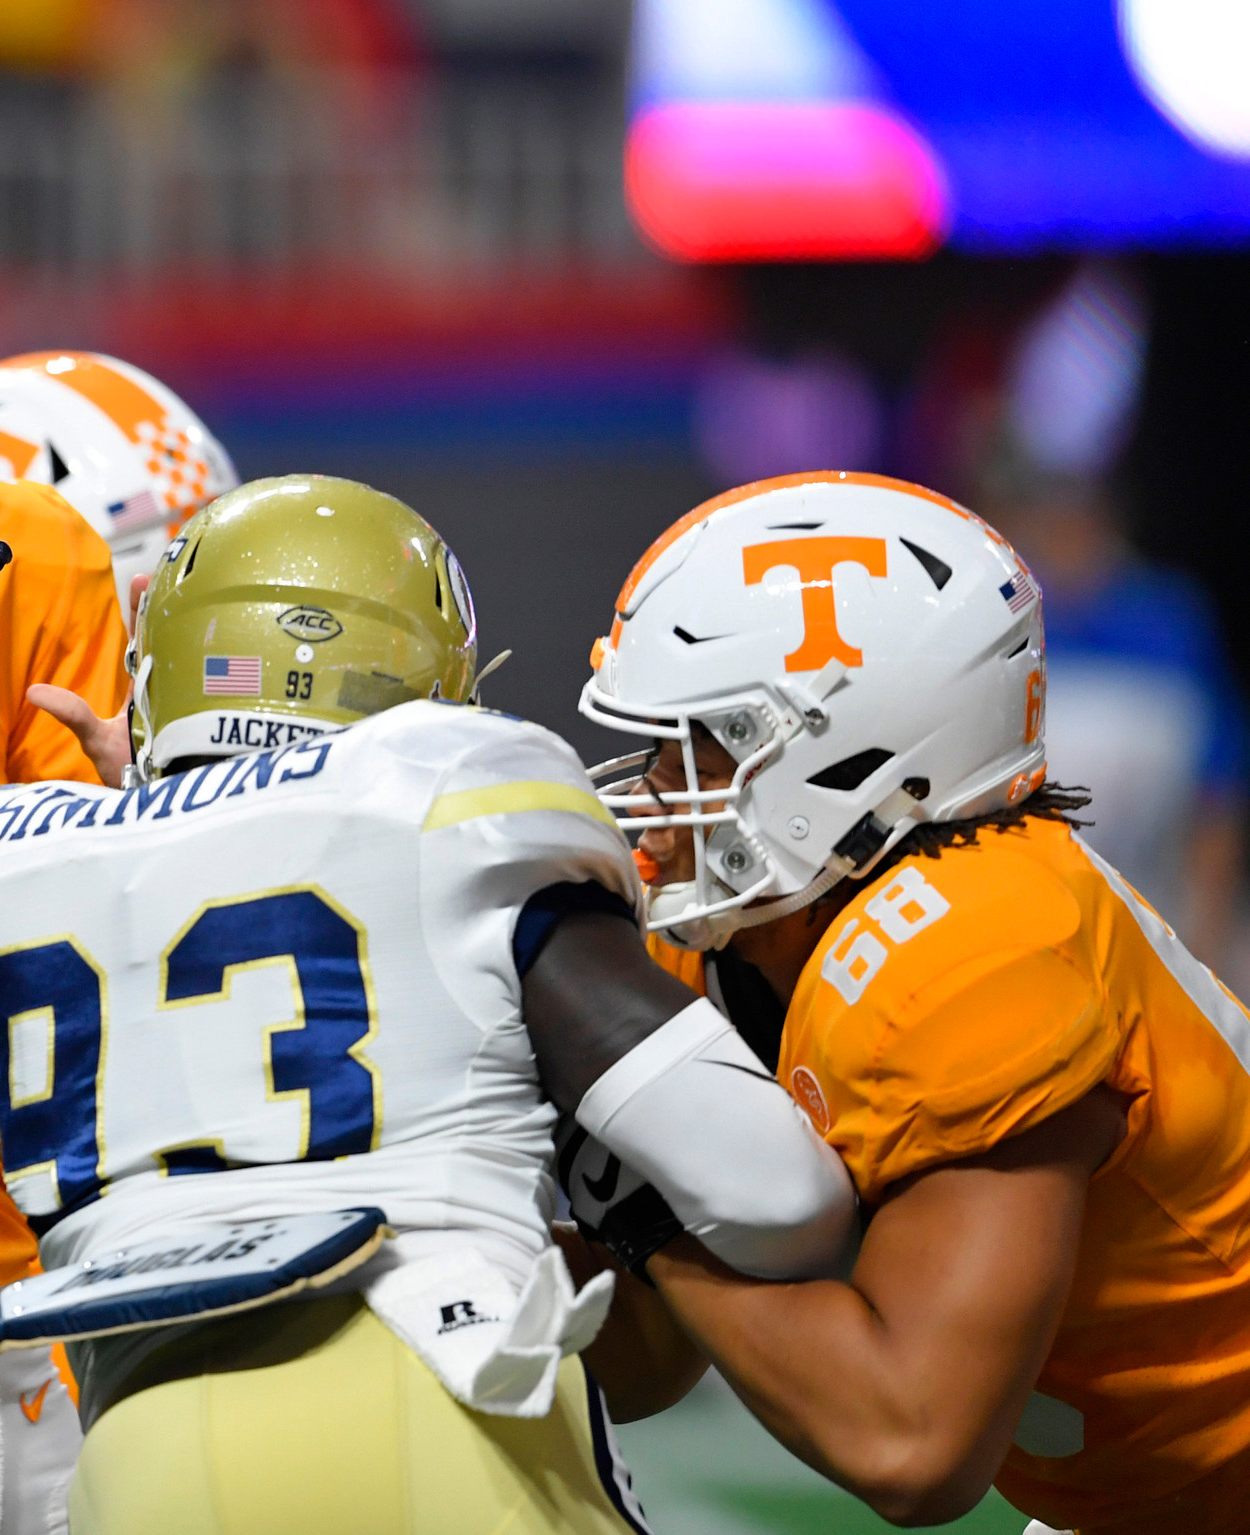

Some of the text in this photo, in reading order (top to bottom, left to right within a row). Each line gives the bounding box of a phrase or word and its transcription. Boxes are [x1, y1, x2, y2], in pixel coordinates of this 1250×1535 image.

[740, 536, 888, 673] T
[286, 614, 334, 631] ACC
[285, 670, 314, 700] 93
[210, 716, 352, 749] JACKET
[821, 866, 951, 1006] 68
